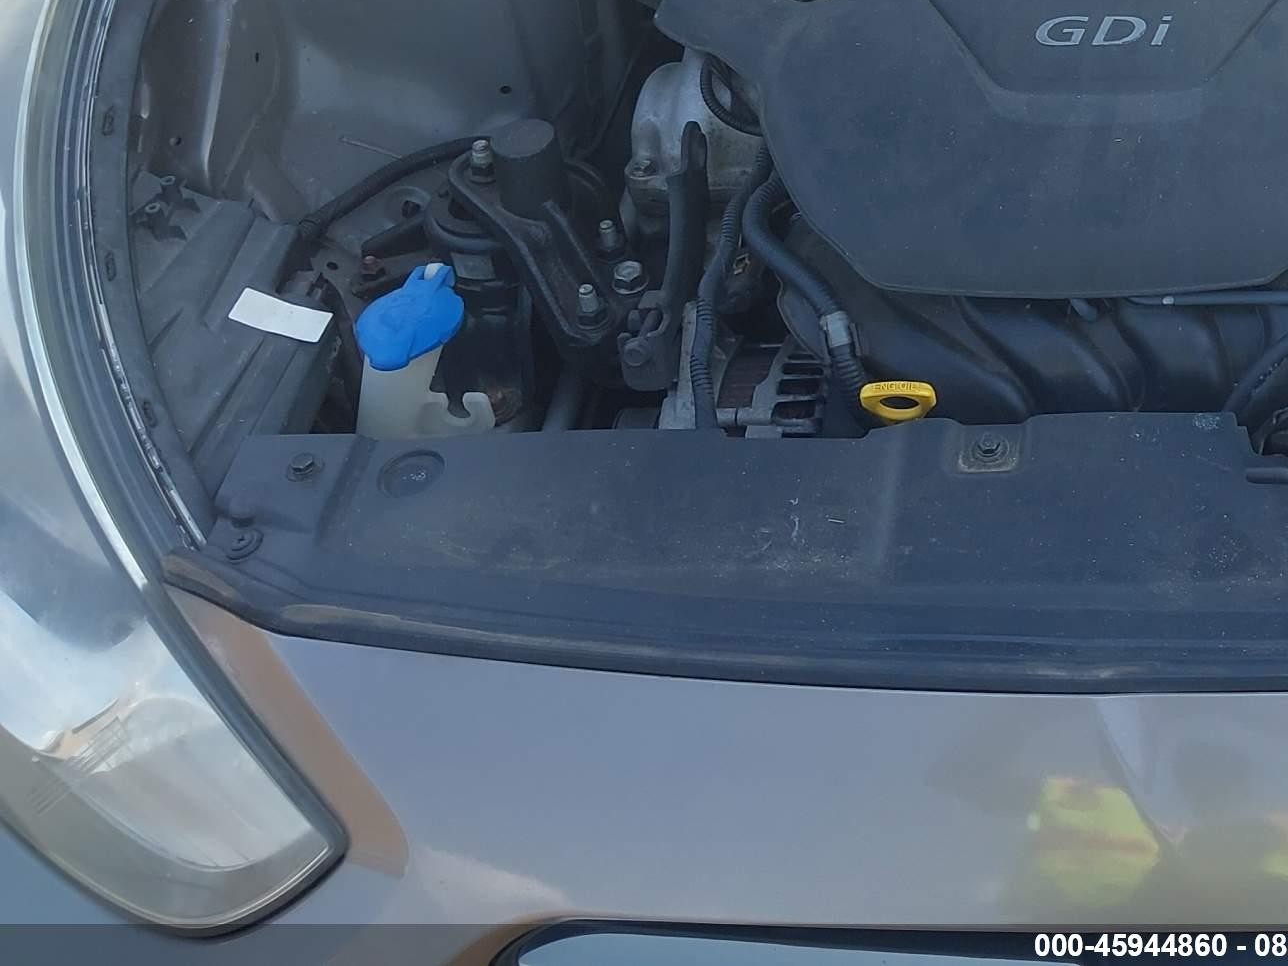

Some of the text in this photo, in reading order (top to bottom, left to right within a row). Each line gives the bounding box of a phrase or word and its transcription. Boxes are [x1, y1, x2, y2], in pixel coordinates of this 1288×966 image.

[1035, 15, 1173, 46] GDi
[872, 382, 919, 390] ENG OIL
